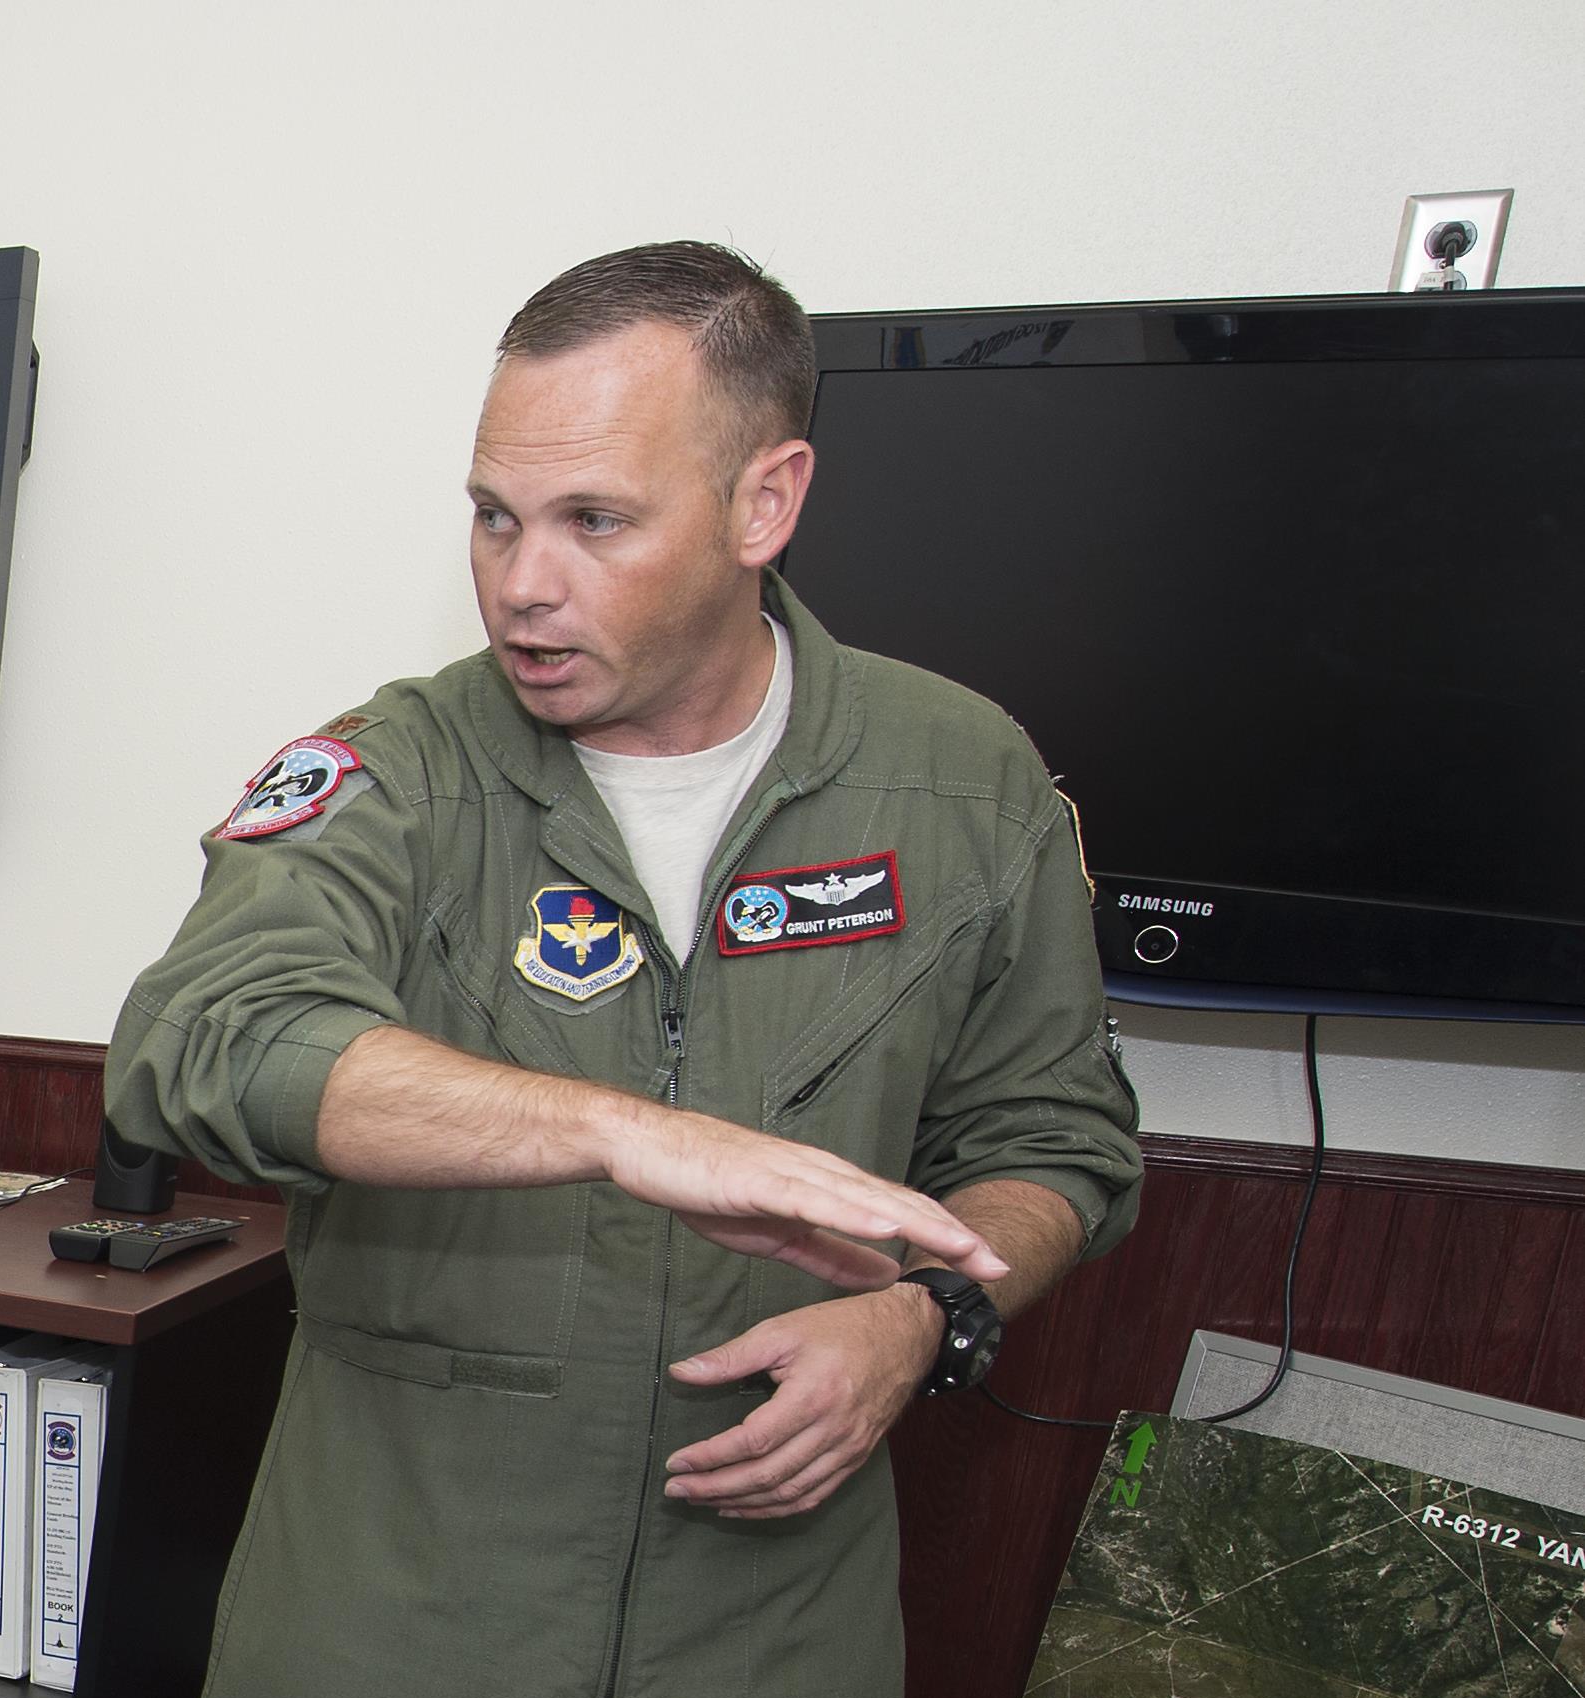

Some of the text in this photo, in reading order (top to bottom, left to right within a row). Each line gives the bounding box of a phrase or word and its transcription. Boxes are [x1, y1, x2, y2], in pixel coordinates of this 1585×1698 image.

[1117, 893, 1214, 917] SAMSUNG
[786, 908, 894, 935] GRUNT PETERSON
[525, 954, 636, 996] AIR EDUCATION AND TRAINING COMMAND
[1109, 1478, 1143, 1508] N
[1422, 1505, 1521, 1549] R-6312
[48, 1601, 73, 1612] BOOK
[58, 1613, 63, 1622] 2
